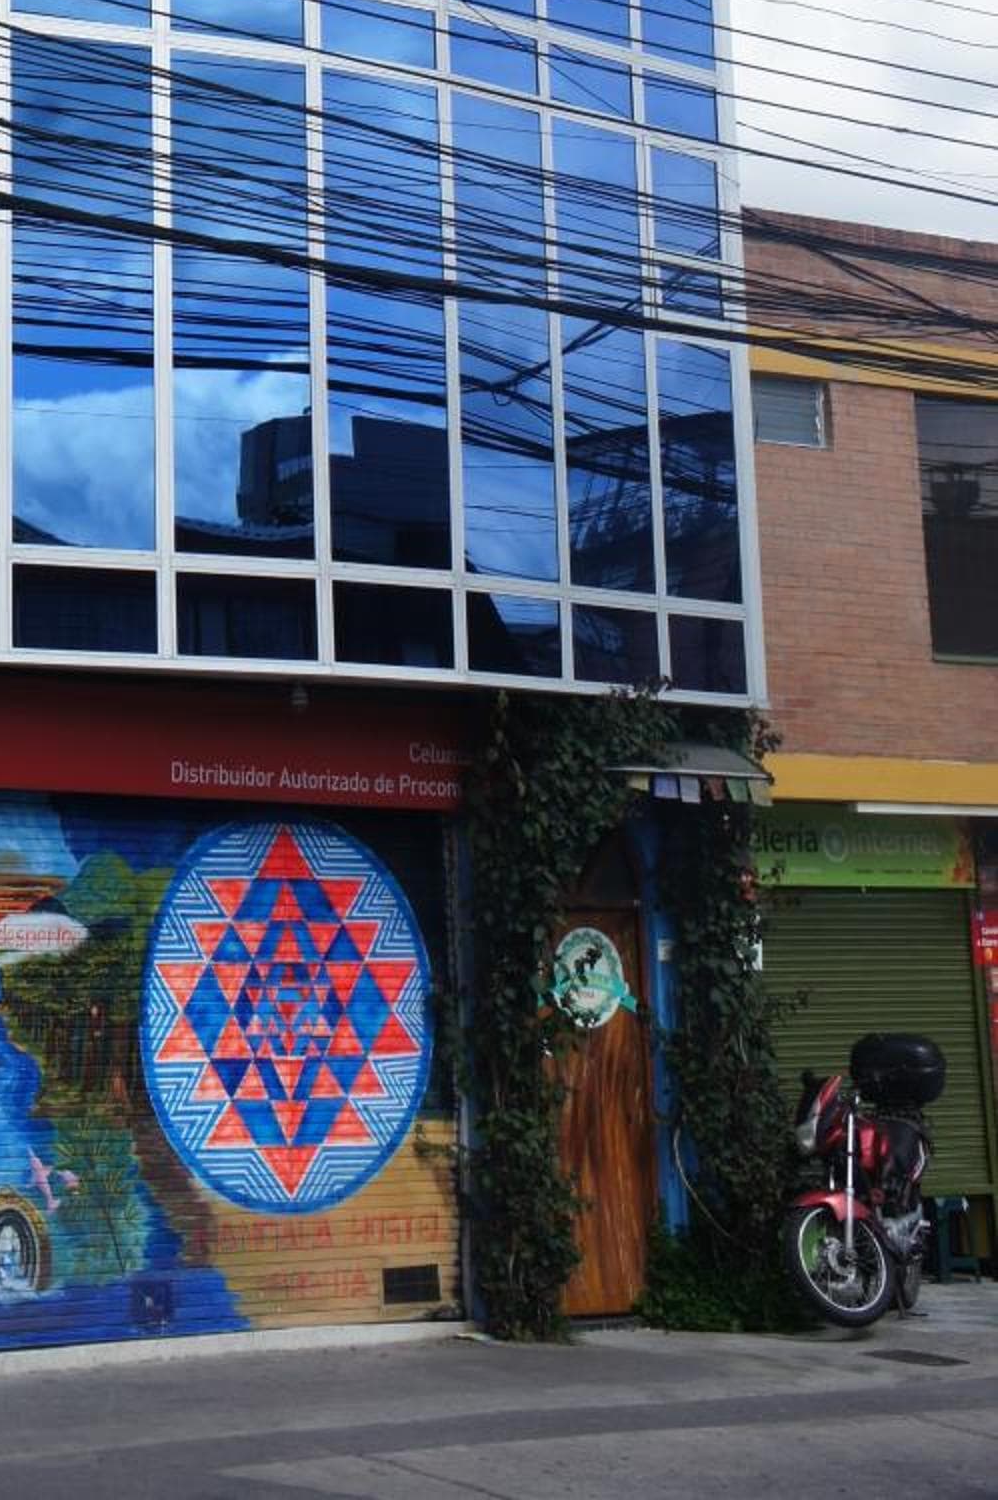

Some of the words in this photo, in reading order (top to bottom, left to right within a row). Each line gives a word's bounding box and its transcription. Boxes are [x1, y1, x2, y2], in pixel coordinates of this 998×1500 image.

[171, 761, 274, 788] Distribuidor
[280, 766, 369, 793] Autorizado
[374, 773, 394, 794] de
